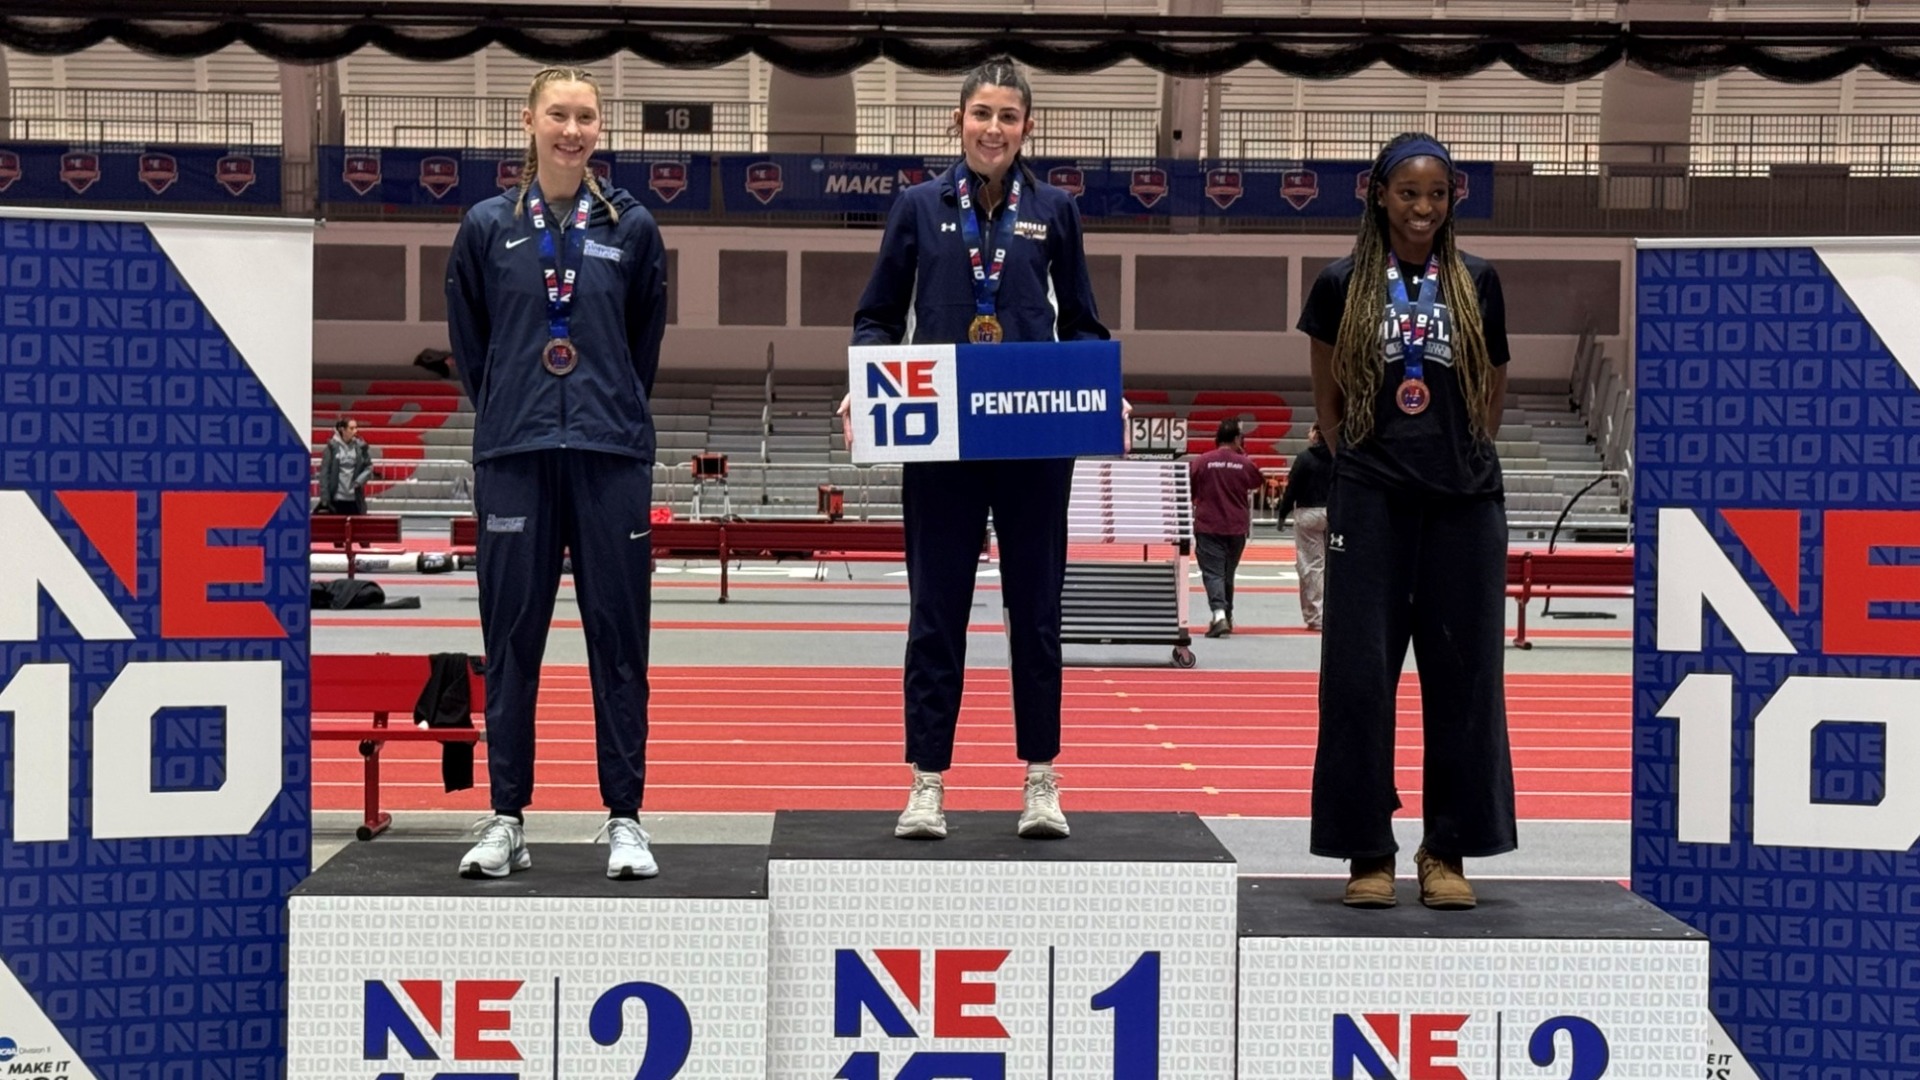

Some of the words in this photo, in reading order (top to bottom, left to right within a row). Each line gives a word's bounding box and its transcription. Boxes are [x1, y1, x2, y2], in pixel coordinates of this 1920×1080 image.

[665, 108, 690, 130] 16
[825, 174, 894, 194] MAKE
[866, 360, 939, 398] NE
[971, 389, 1107, 416] PENTATHLON
[868, 402, 939, 447] 10
[0, 490, 289, 641] NE
[1656, 508, 1920, 657] NE
[0, 660, 282, 843] 10
[1655, 673, 1920, 850] 10
[363, 980, 525, 1061] NE
[834, 949, 1012, 1038] NE
[8, 1062, 53, 1075] MAKE
[56, 1061, 70, 1072] IT
[1333, 1014, 1471, 1080] NE
[1718, 1054, 1733, 1066] IT
